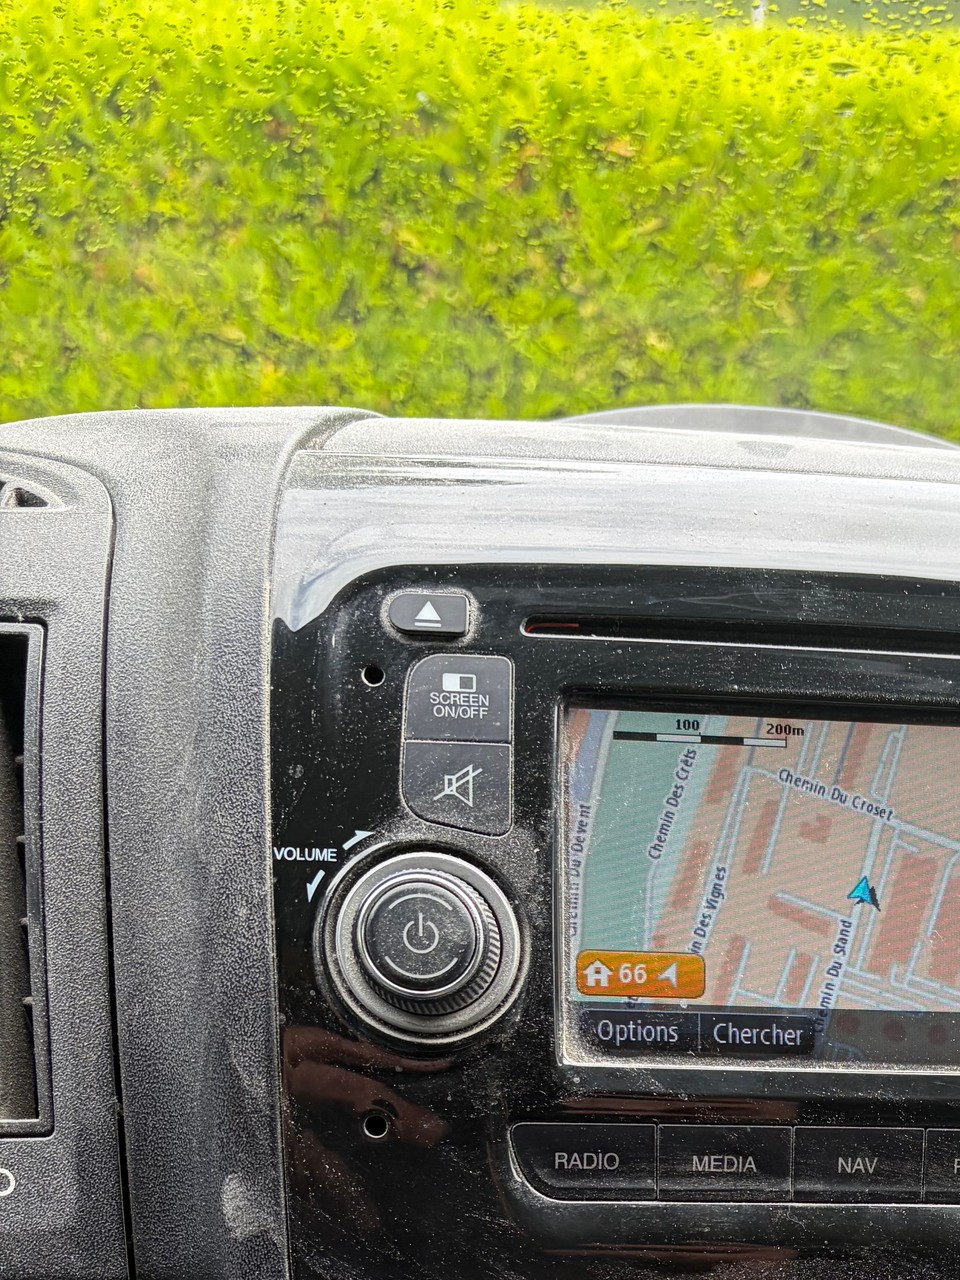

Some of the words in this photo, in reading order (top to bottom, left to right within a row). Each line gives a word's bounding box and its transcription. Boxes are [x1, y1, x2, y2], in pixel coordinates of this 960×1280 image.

[429, 692, 490, 706] SCREEN
[432, 706, 489, 719] ON/OFF
[675, 719, 700, 731] 100
[766, 723, 805, 737] 200m
[778, 768, 826, 797] Chemin
[830, 787, 848, 805] Du
[852, 796, 894, 821] Croset
[570, 803, 591, 852] Devent
[648, 810, 676, 860] Chemin
[665, 783, 685, 808] Des
[272, 846, 338, 862] VOLUME
[694, 912, 712, 938] Des
[704, 866, 726, 910] Vignes
[834, 918, 853, 956] Stand
[618, 962, 647, 984] 66
[826, 961, 843, 977] Du
[597, 1019, 679, 1047] Options
[713, 1022, 803, 1046] Chercher
[554, 1152, 620, 1170] RADIO
[691, 1155, 757, 1173] MEDIA
[837, 1157, 879, 1174] NAV
